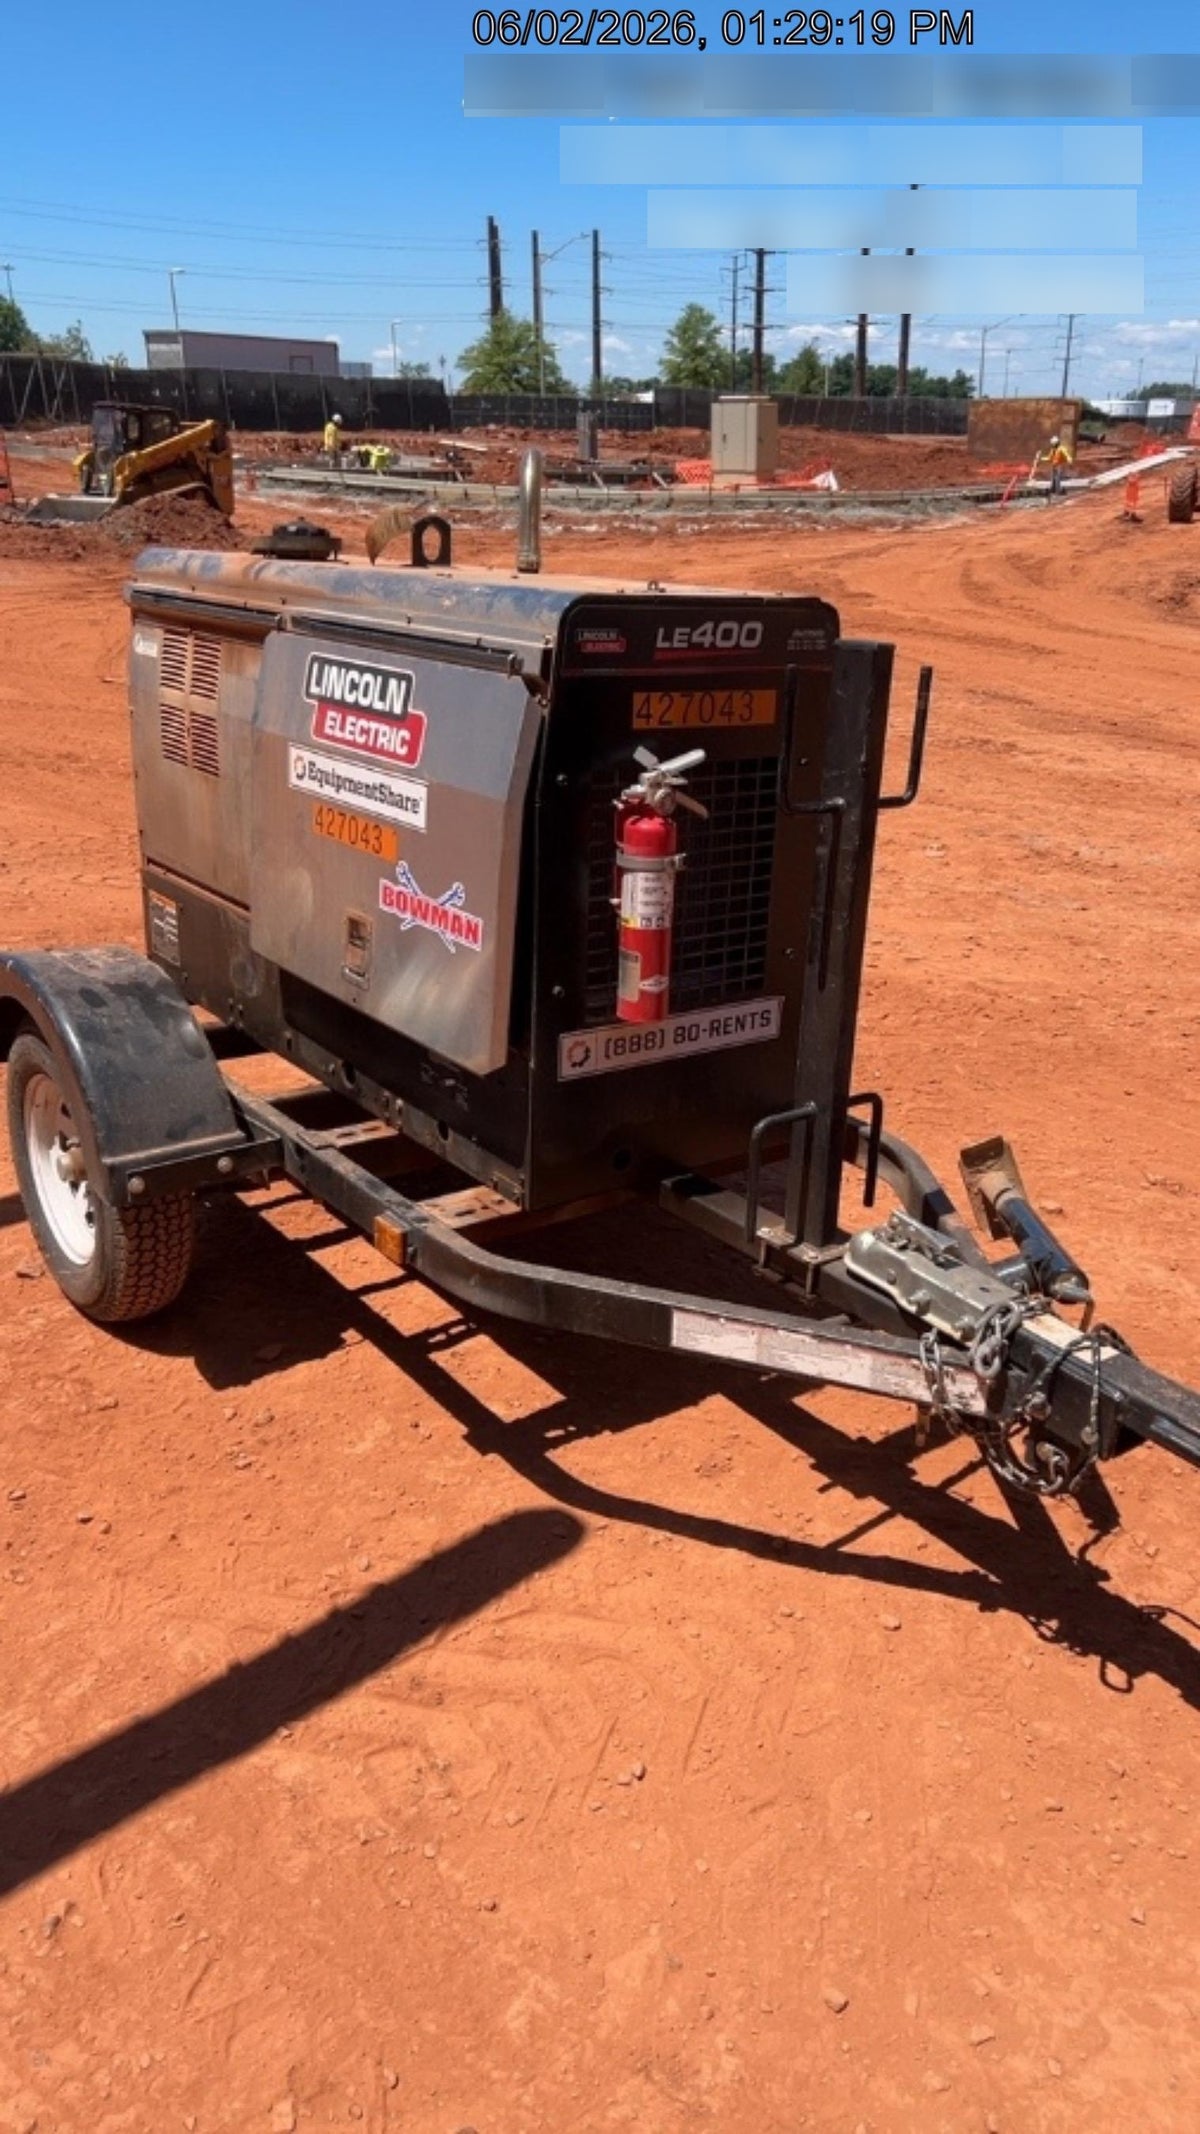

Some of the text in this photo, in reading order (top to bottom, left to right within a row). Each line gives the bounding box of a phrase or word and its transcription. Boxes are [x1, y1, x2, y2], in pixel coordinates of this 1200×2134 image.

[577, 631, 619, 641] LINCOLN
[656, 620, 764, 648] LE400
[309, 661, 407, 715] LINCOLN
[636, 690, 754, 726] 427043
[323, 711, 411, 756] ELECTRIC
[306, 760, 421, 814] EquipmentShare
[314, 804, 383, 855] 427043
[380, 884, 480, 945] BOWMAN
[604, 1009, 772, 1060] (888) 80-RENTS
